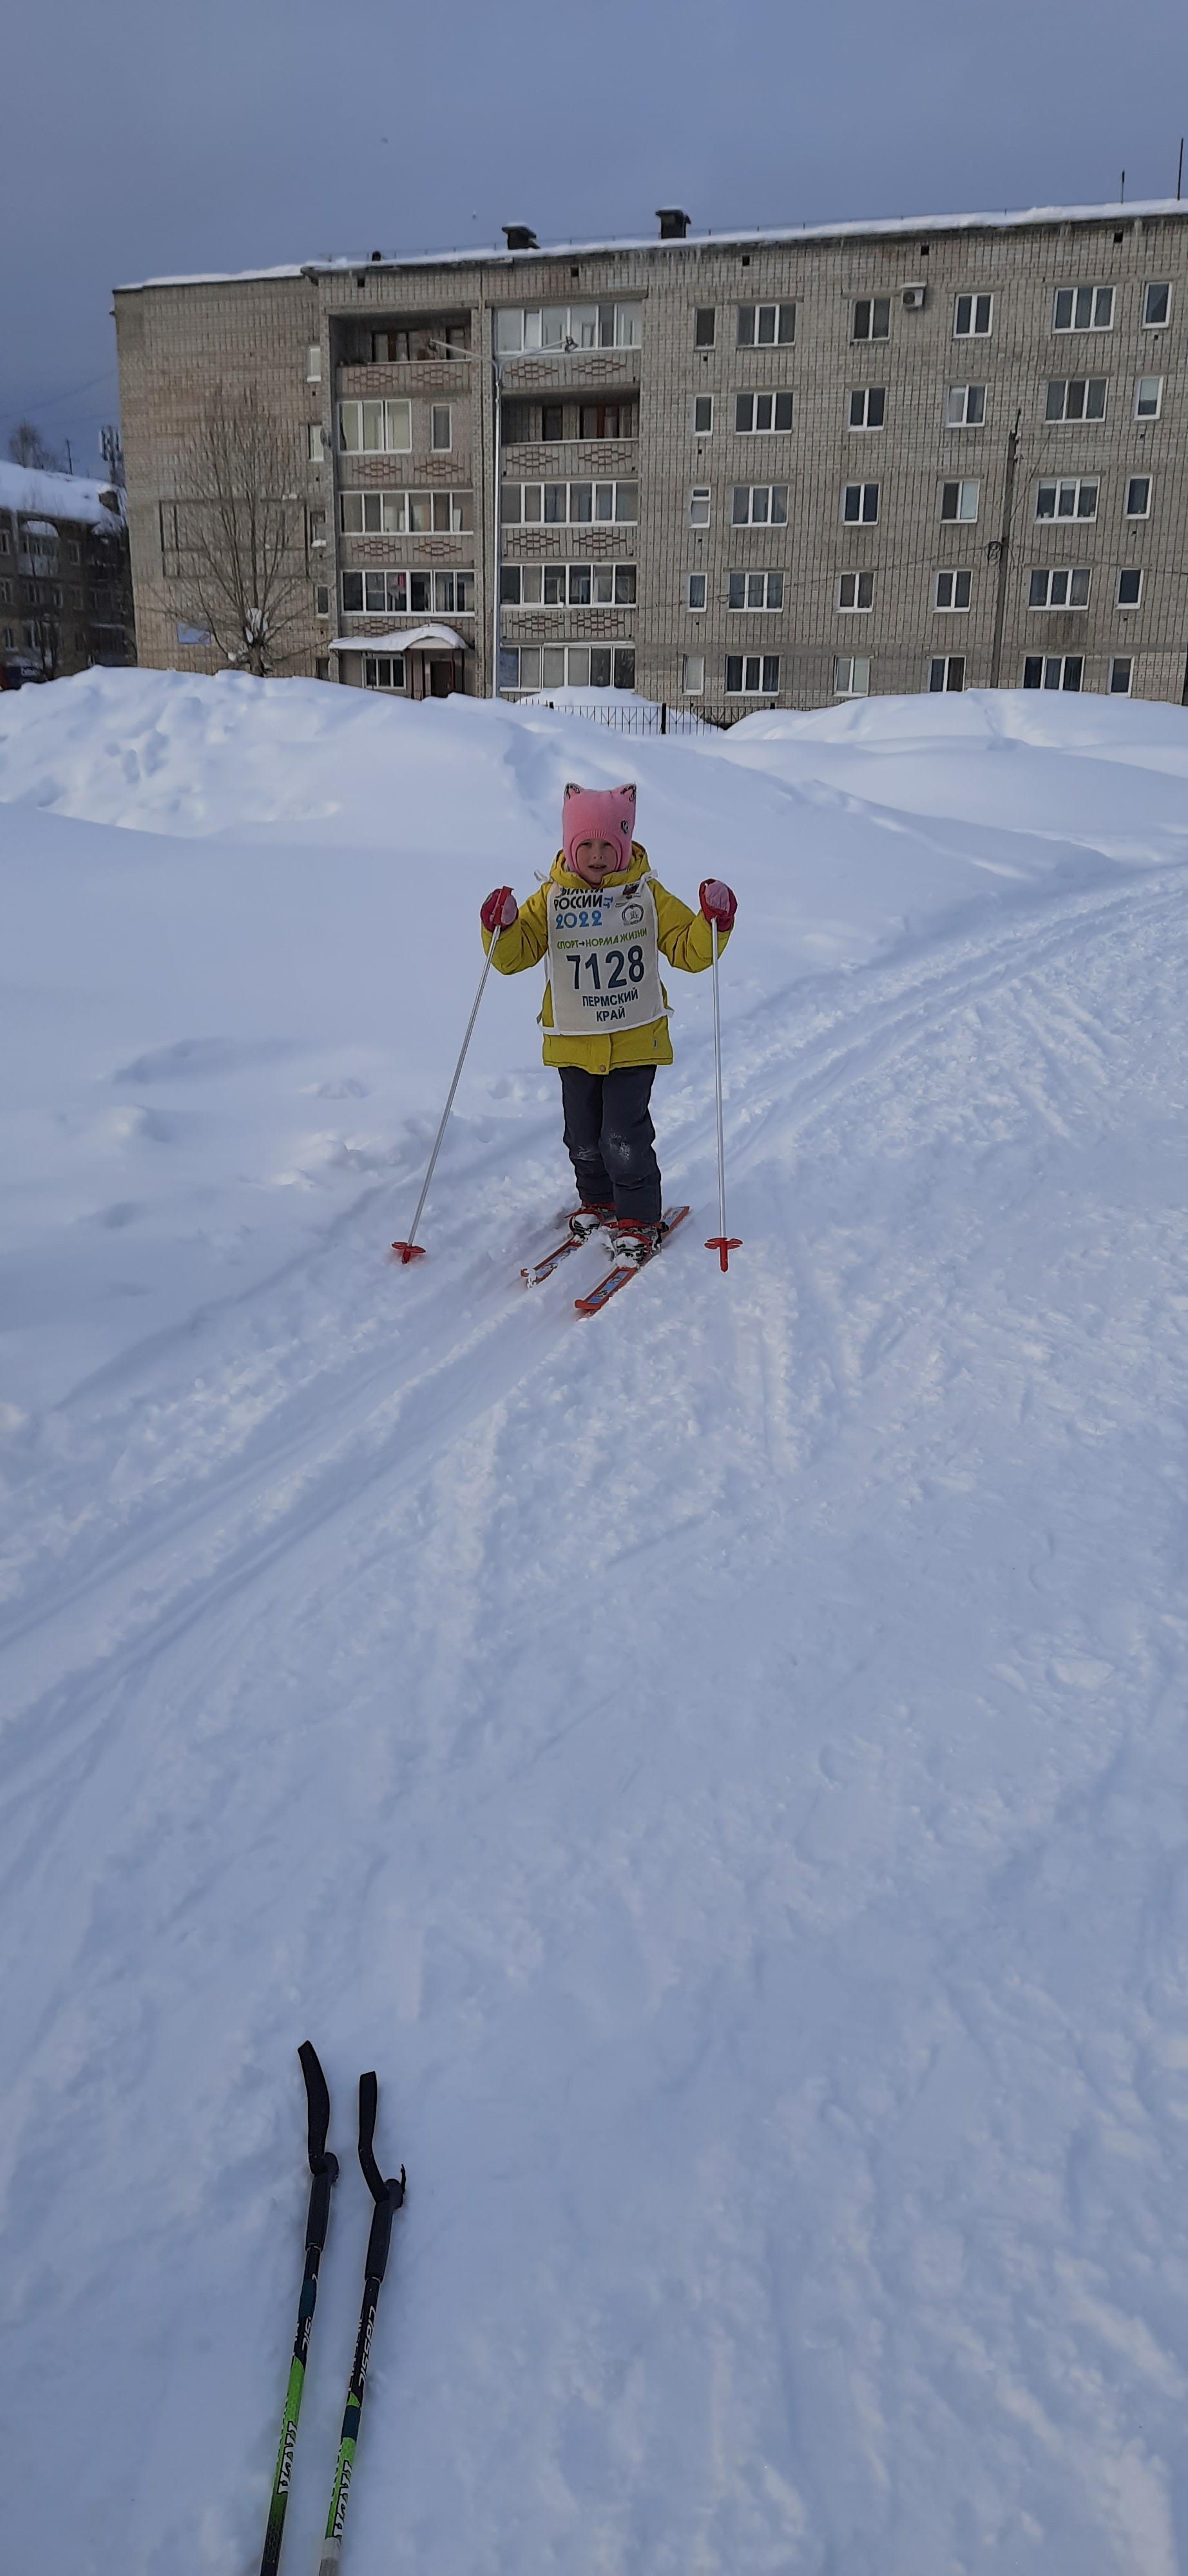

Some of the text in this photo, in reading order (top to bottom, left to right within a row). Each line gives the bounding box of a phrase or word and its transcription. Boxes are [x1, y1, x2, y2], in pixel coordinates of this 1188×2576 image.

[553, 895, 602, 911] РОССИИ
[555, 910, 602, 929] 2022
[557, 927, 647, 949] СПОРТ НОРМА ЖИЗНИ
[566, 945, 645, 990] 7128
[582, 987, 638, 1007] ПЕРМСКИЙ
[596, 1006, 626, 1022] КРАЙ
